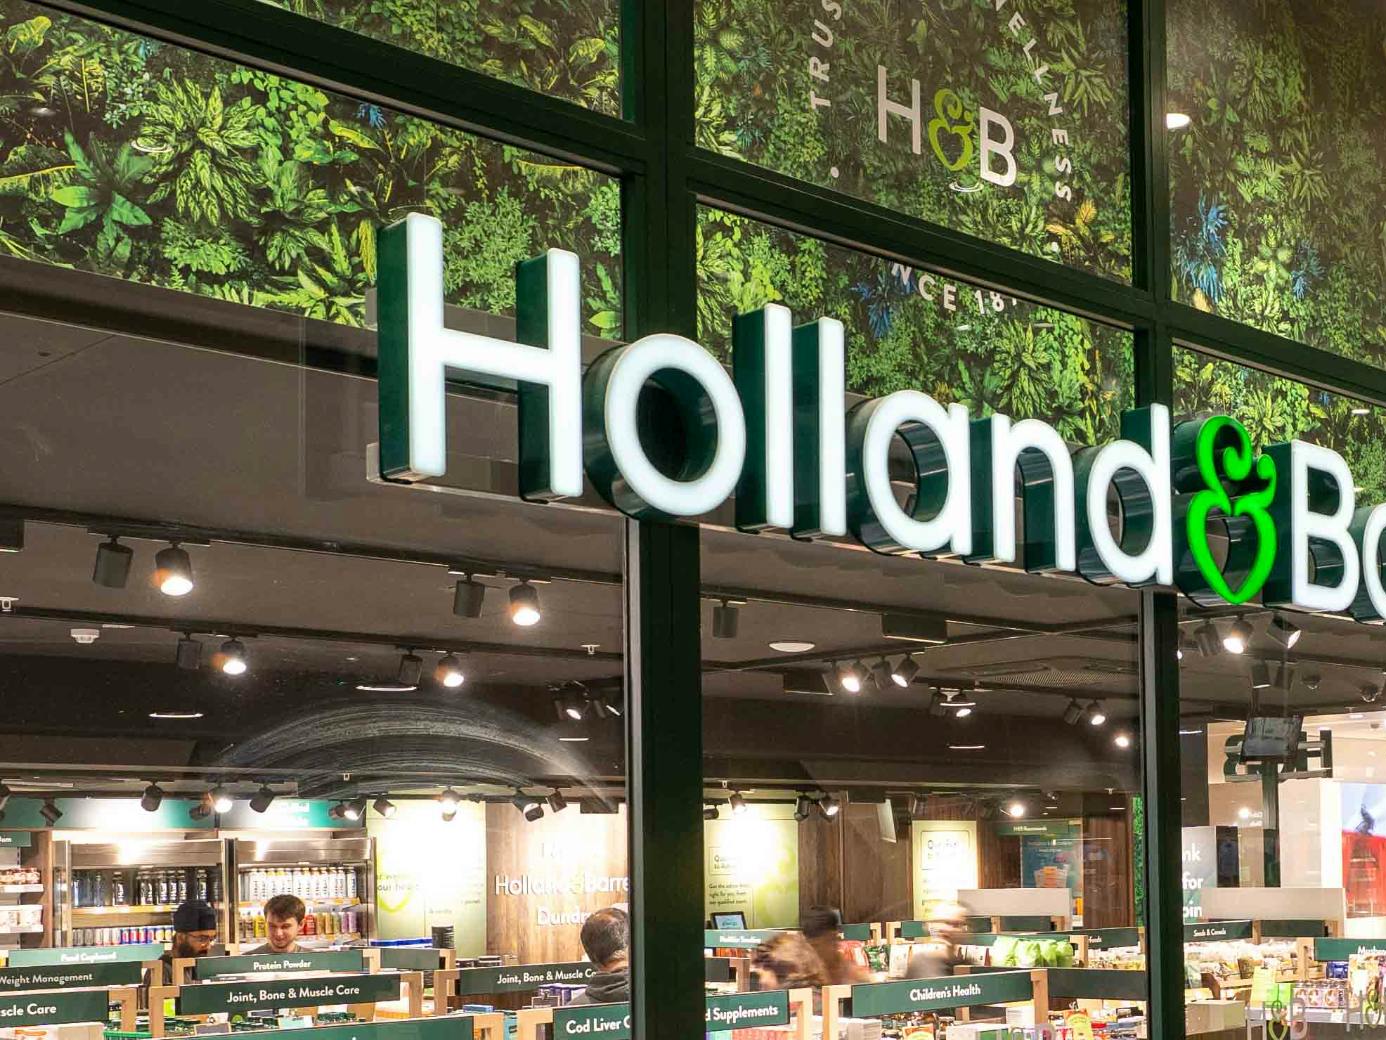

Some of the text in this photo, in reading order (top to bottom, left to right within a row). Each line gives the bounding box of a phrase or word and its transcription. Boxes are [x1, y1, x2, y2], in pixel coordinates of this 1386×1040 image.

[809, 0, 842, 109] TRUS
[878, 64, 1016, 187] H&B
[891, 262, 957, 311] NCE
[405, 210, 1174, 586] Holland
[537, 906, 590, 926] Dundr
[253, 960, 311, 970] Protein Powder
[0, 974, 93, 987] Weight Management
[497, 968, 597, 985] Joint, Bone & Muscle Ca
[227, 985, 360, 1004] Joint, Bone & Muscle Care
[910, 983, 981, 1002] Children's Health
[0, 1003, 57, 1017] scle Care
[565, 1018, 590, 1035] Cod
[593, 1017, 622, 1032] Liver
[713, 1004, 779, 1023] Supplements
